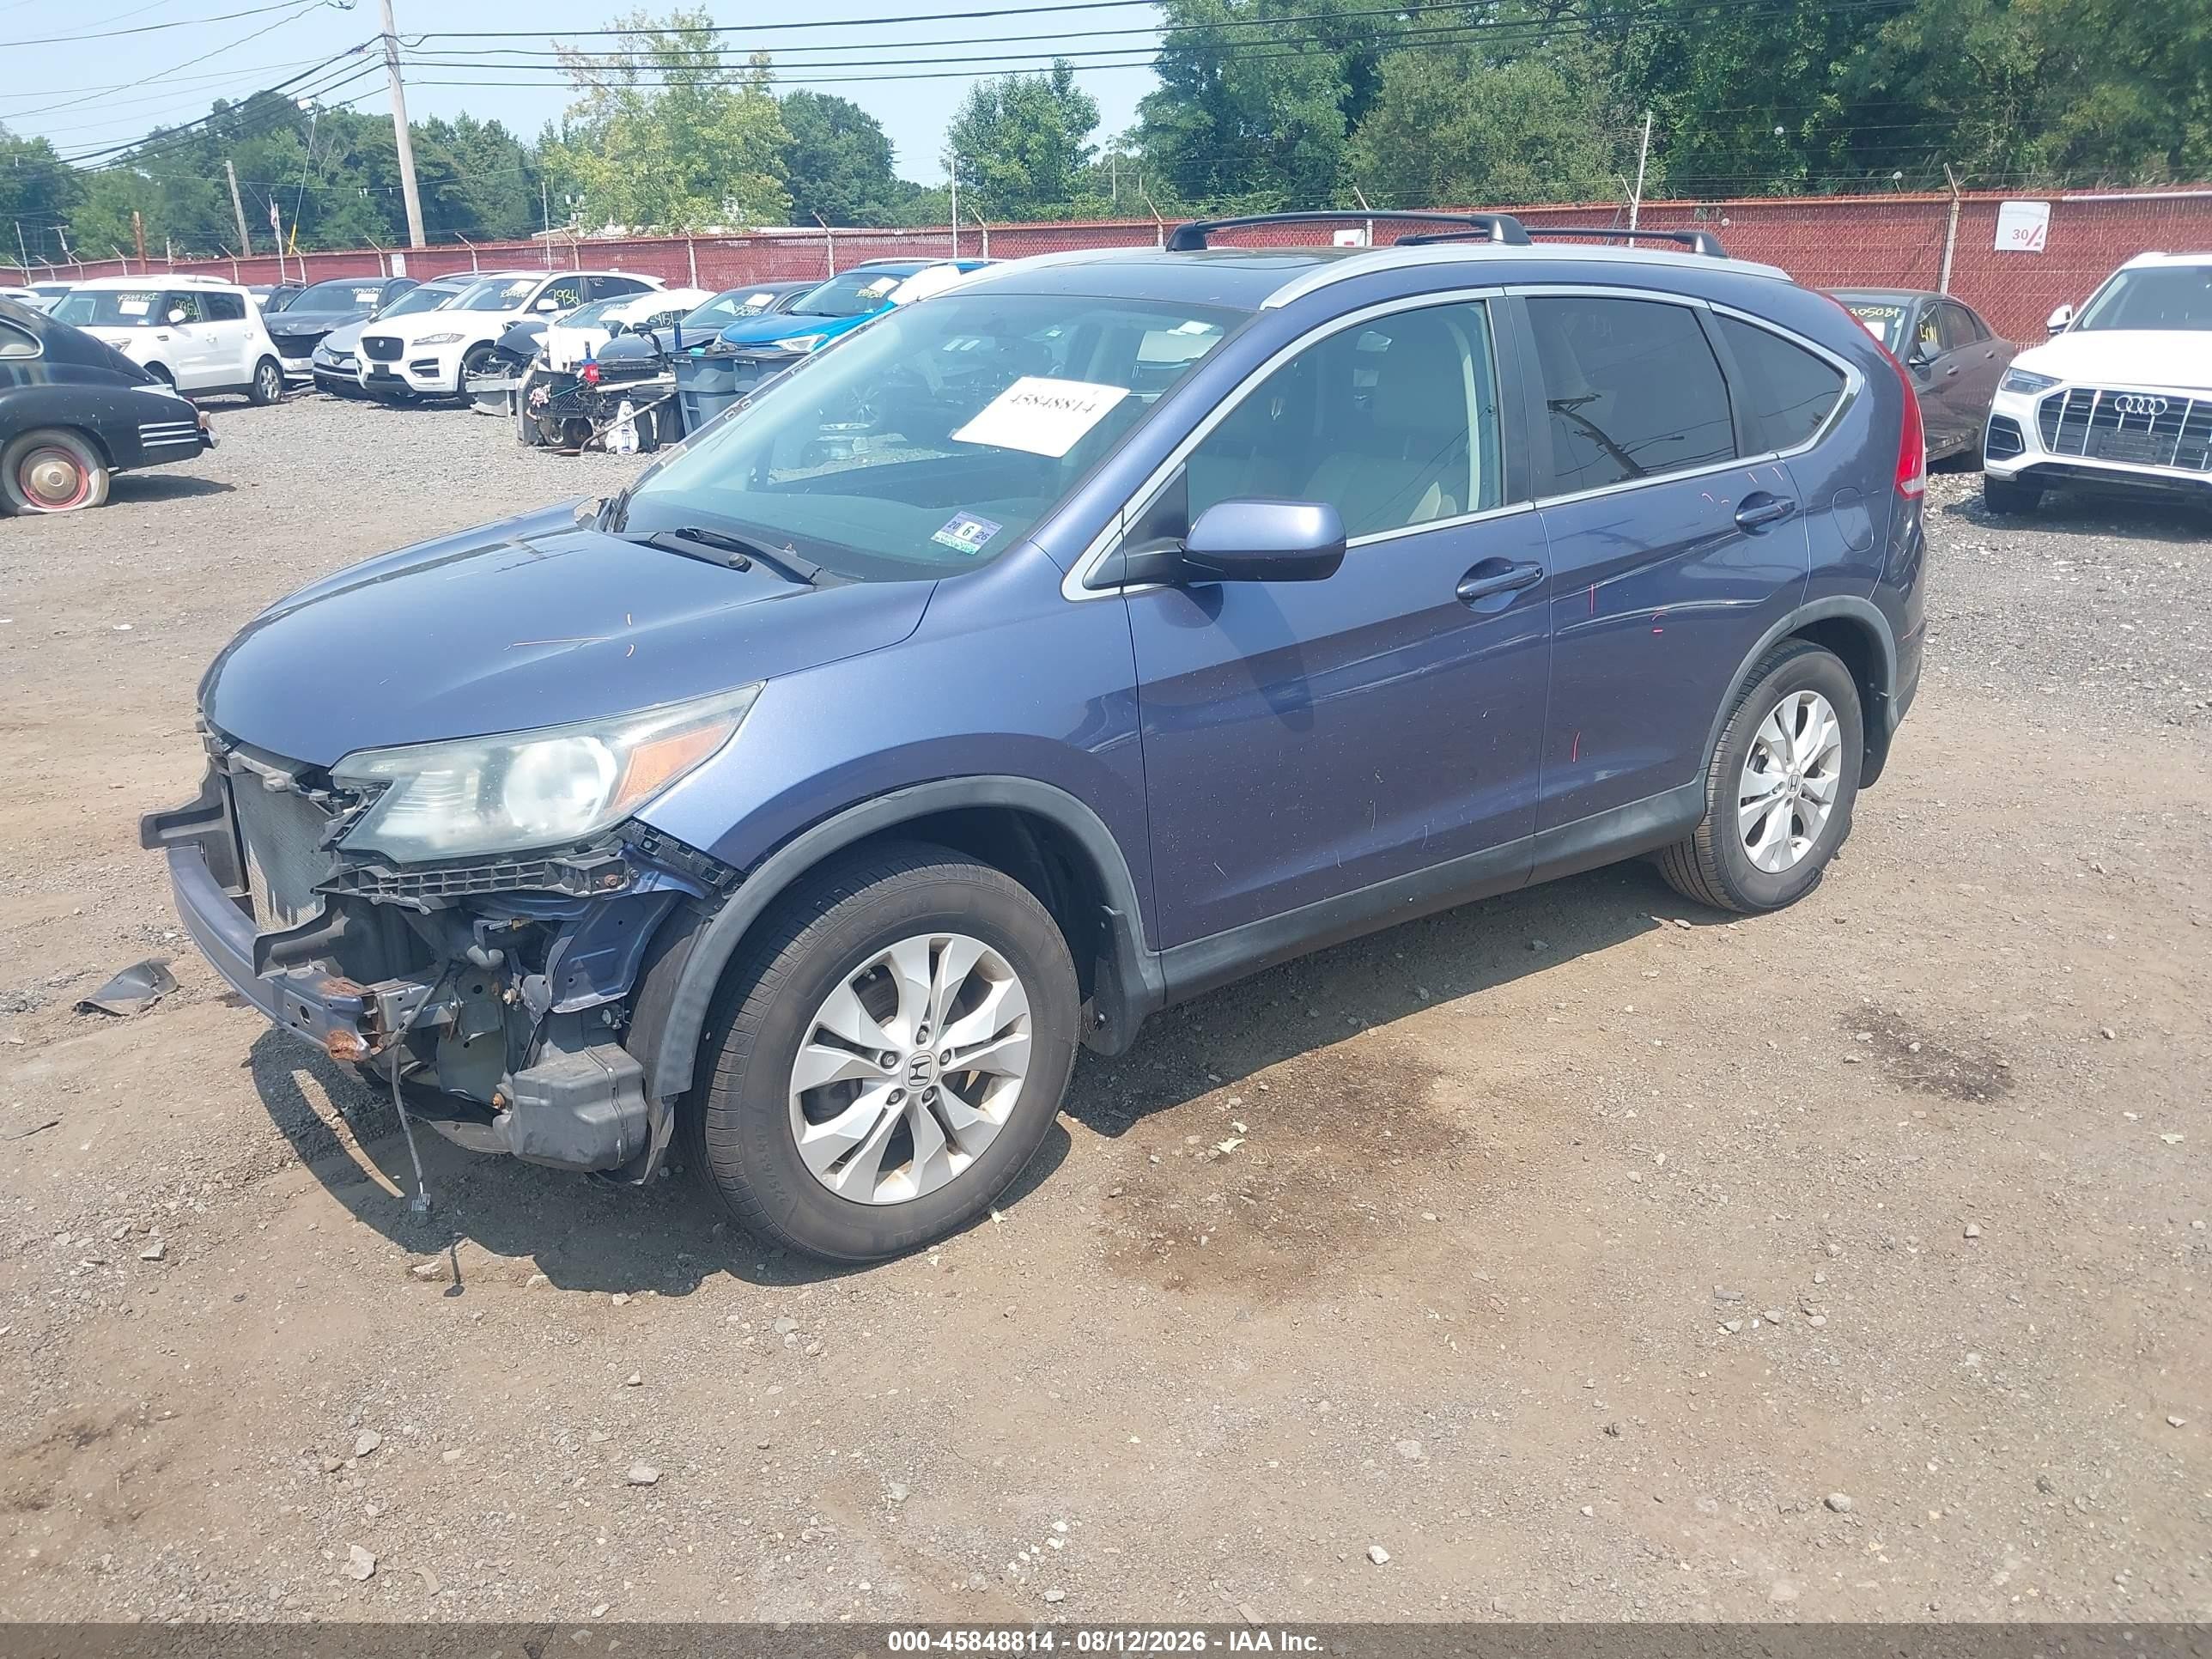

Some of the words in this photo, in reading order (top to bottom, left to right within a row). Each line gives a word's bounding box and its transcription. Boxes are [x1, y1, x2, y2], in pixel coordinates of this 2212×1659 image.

[947, 520, 962, 530] 20
[963, 526, 975, 537] 6
[975, 531, 990, 541] 26
